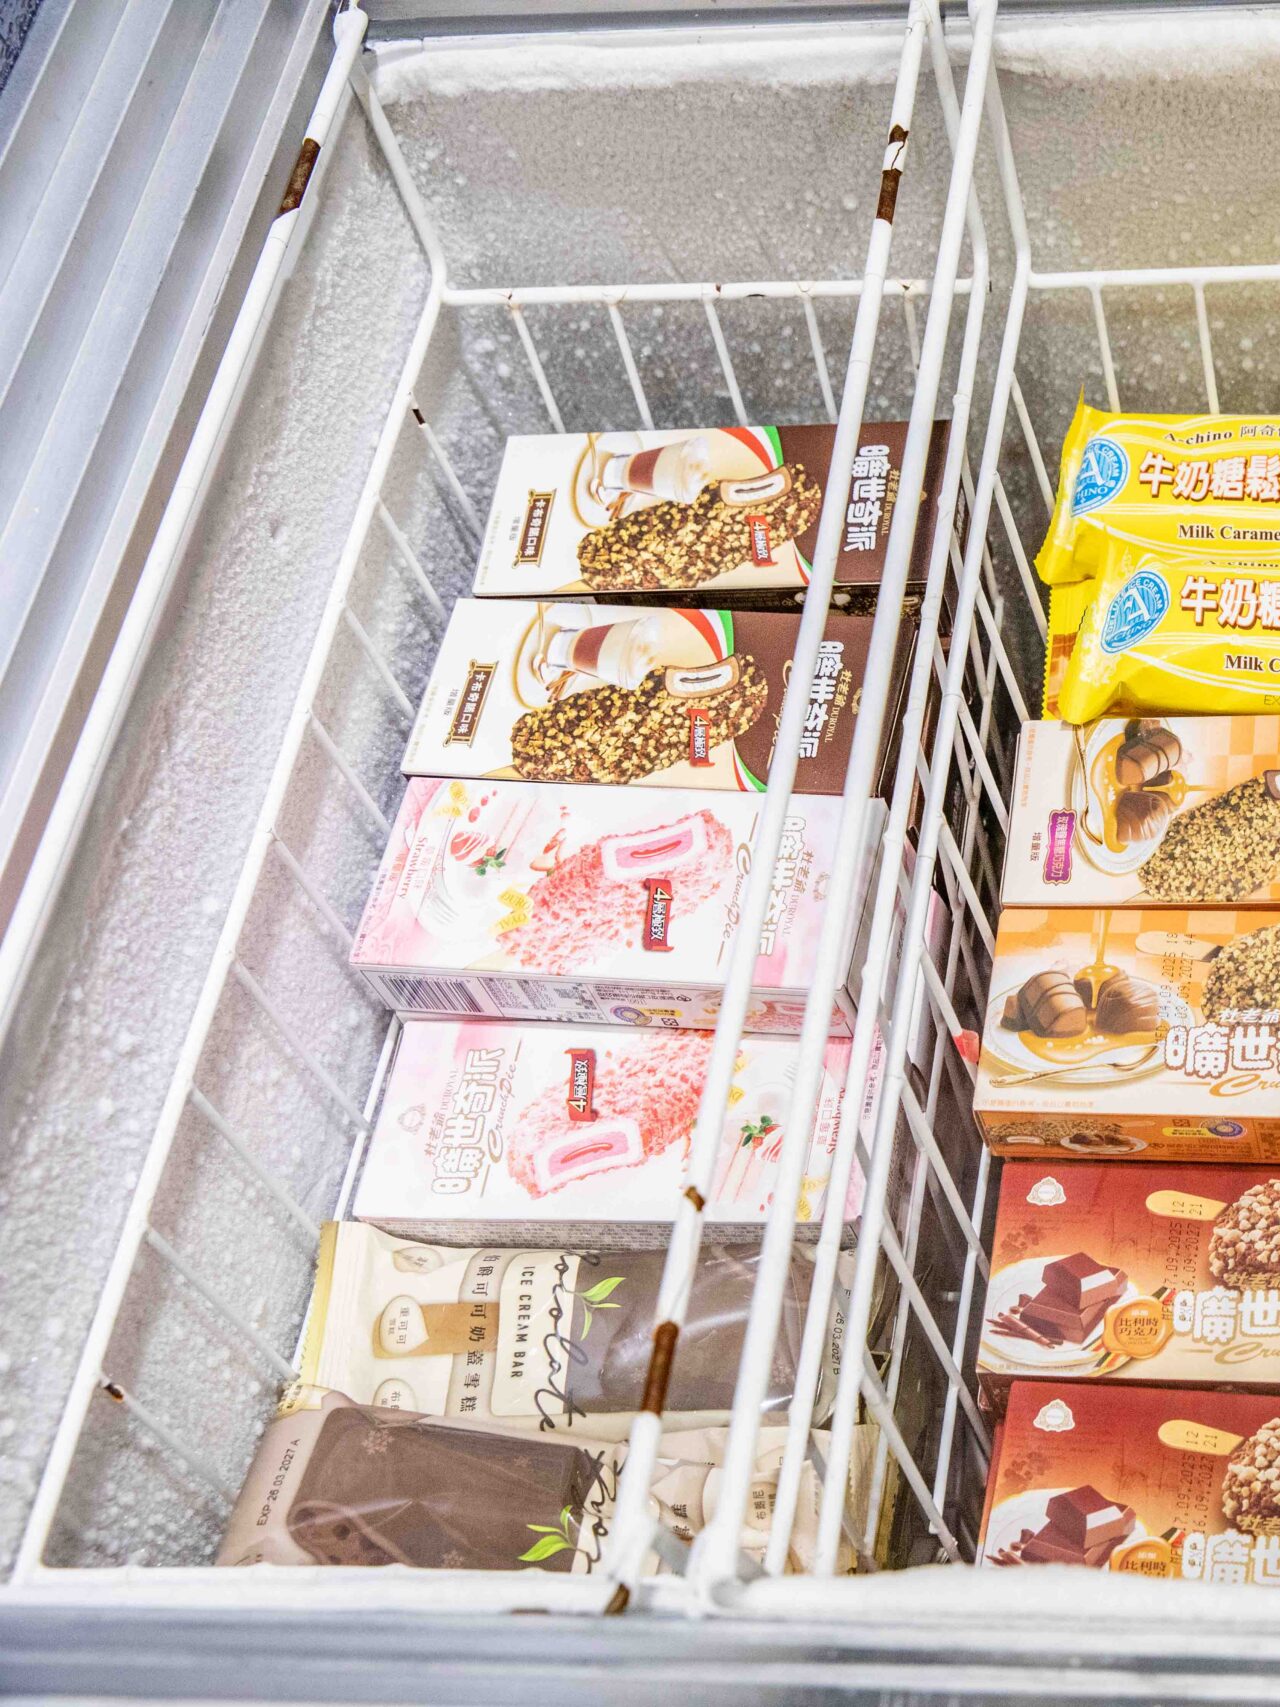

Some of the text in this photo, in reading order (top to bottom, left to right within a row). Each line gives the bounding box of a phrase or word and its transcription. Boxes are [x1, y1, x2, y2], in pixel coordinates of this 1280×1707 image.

[880, 502, 895, 535] DUROYAL
[1178, 525, 1216, 540] Milk
[1224, 654, 1264, 671] Milk
[824, 707, 841, 743] DUROYAL
[399, 836, 428, 900] Strawberry
[650, 887, 672, 941] 4層極致
[1219, 1008, 1280, 1024] 杜老爺
[568, 1058, 589, 1113] 4層極致
[509, 1265, 536, 1379] ICE CREAM BAR
[1118, 1316, 1160, 1328] 比利時
[1118, 1327, 1160, 1338] 巧克力
[256, 1501, 271, 1528] EXP
[292, 1437, 302, 1447] A
